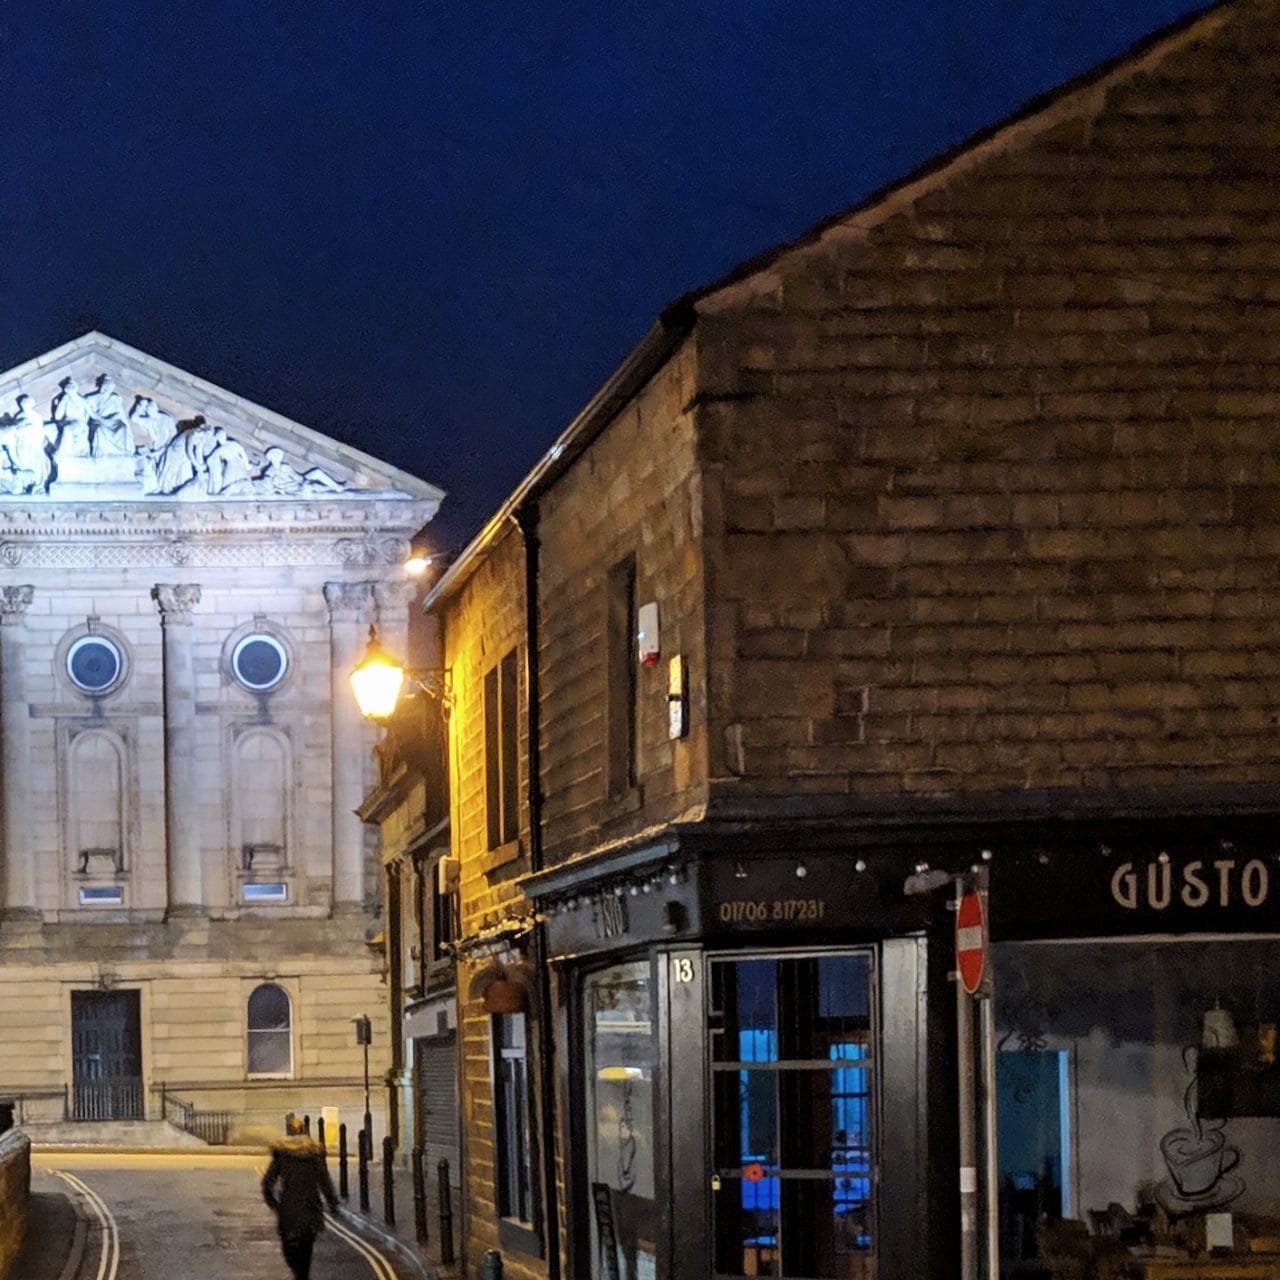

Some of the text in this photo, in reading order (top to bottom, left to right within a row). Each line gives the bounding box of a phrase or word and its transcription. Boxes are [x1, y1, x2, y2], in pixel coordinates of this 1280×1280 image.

[1111, 859, 1268, 909] GUSTO
[719, 898, 825, 921] 01706 817231
[673, 958, 693, 982] 13
